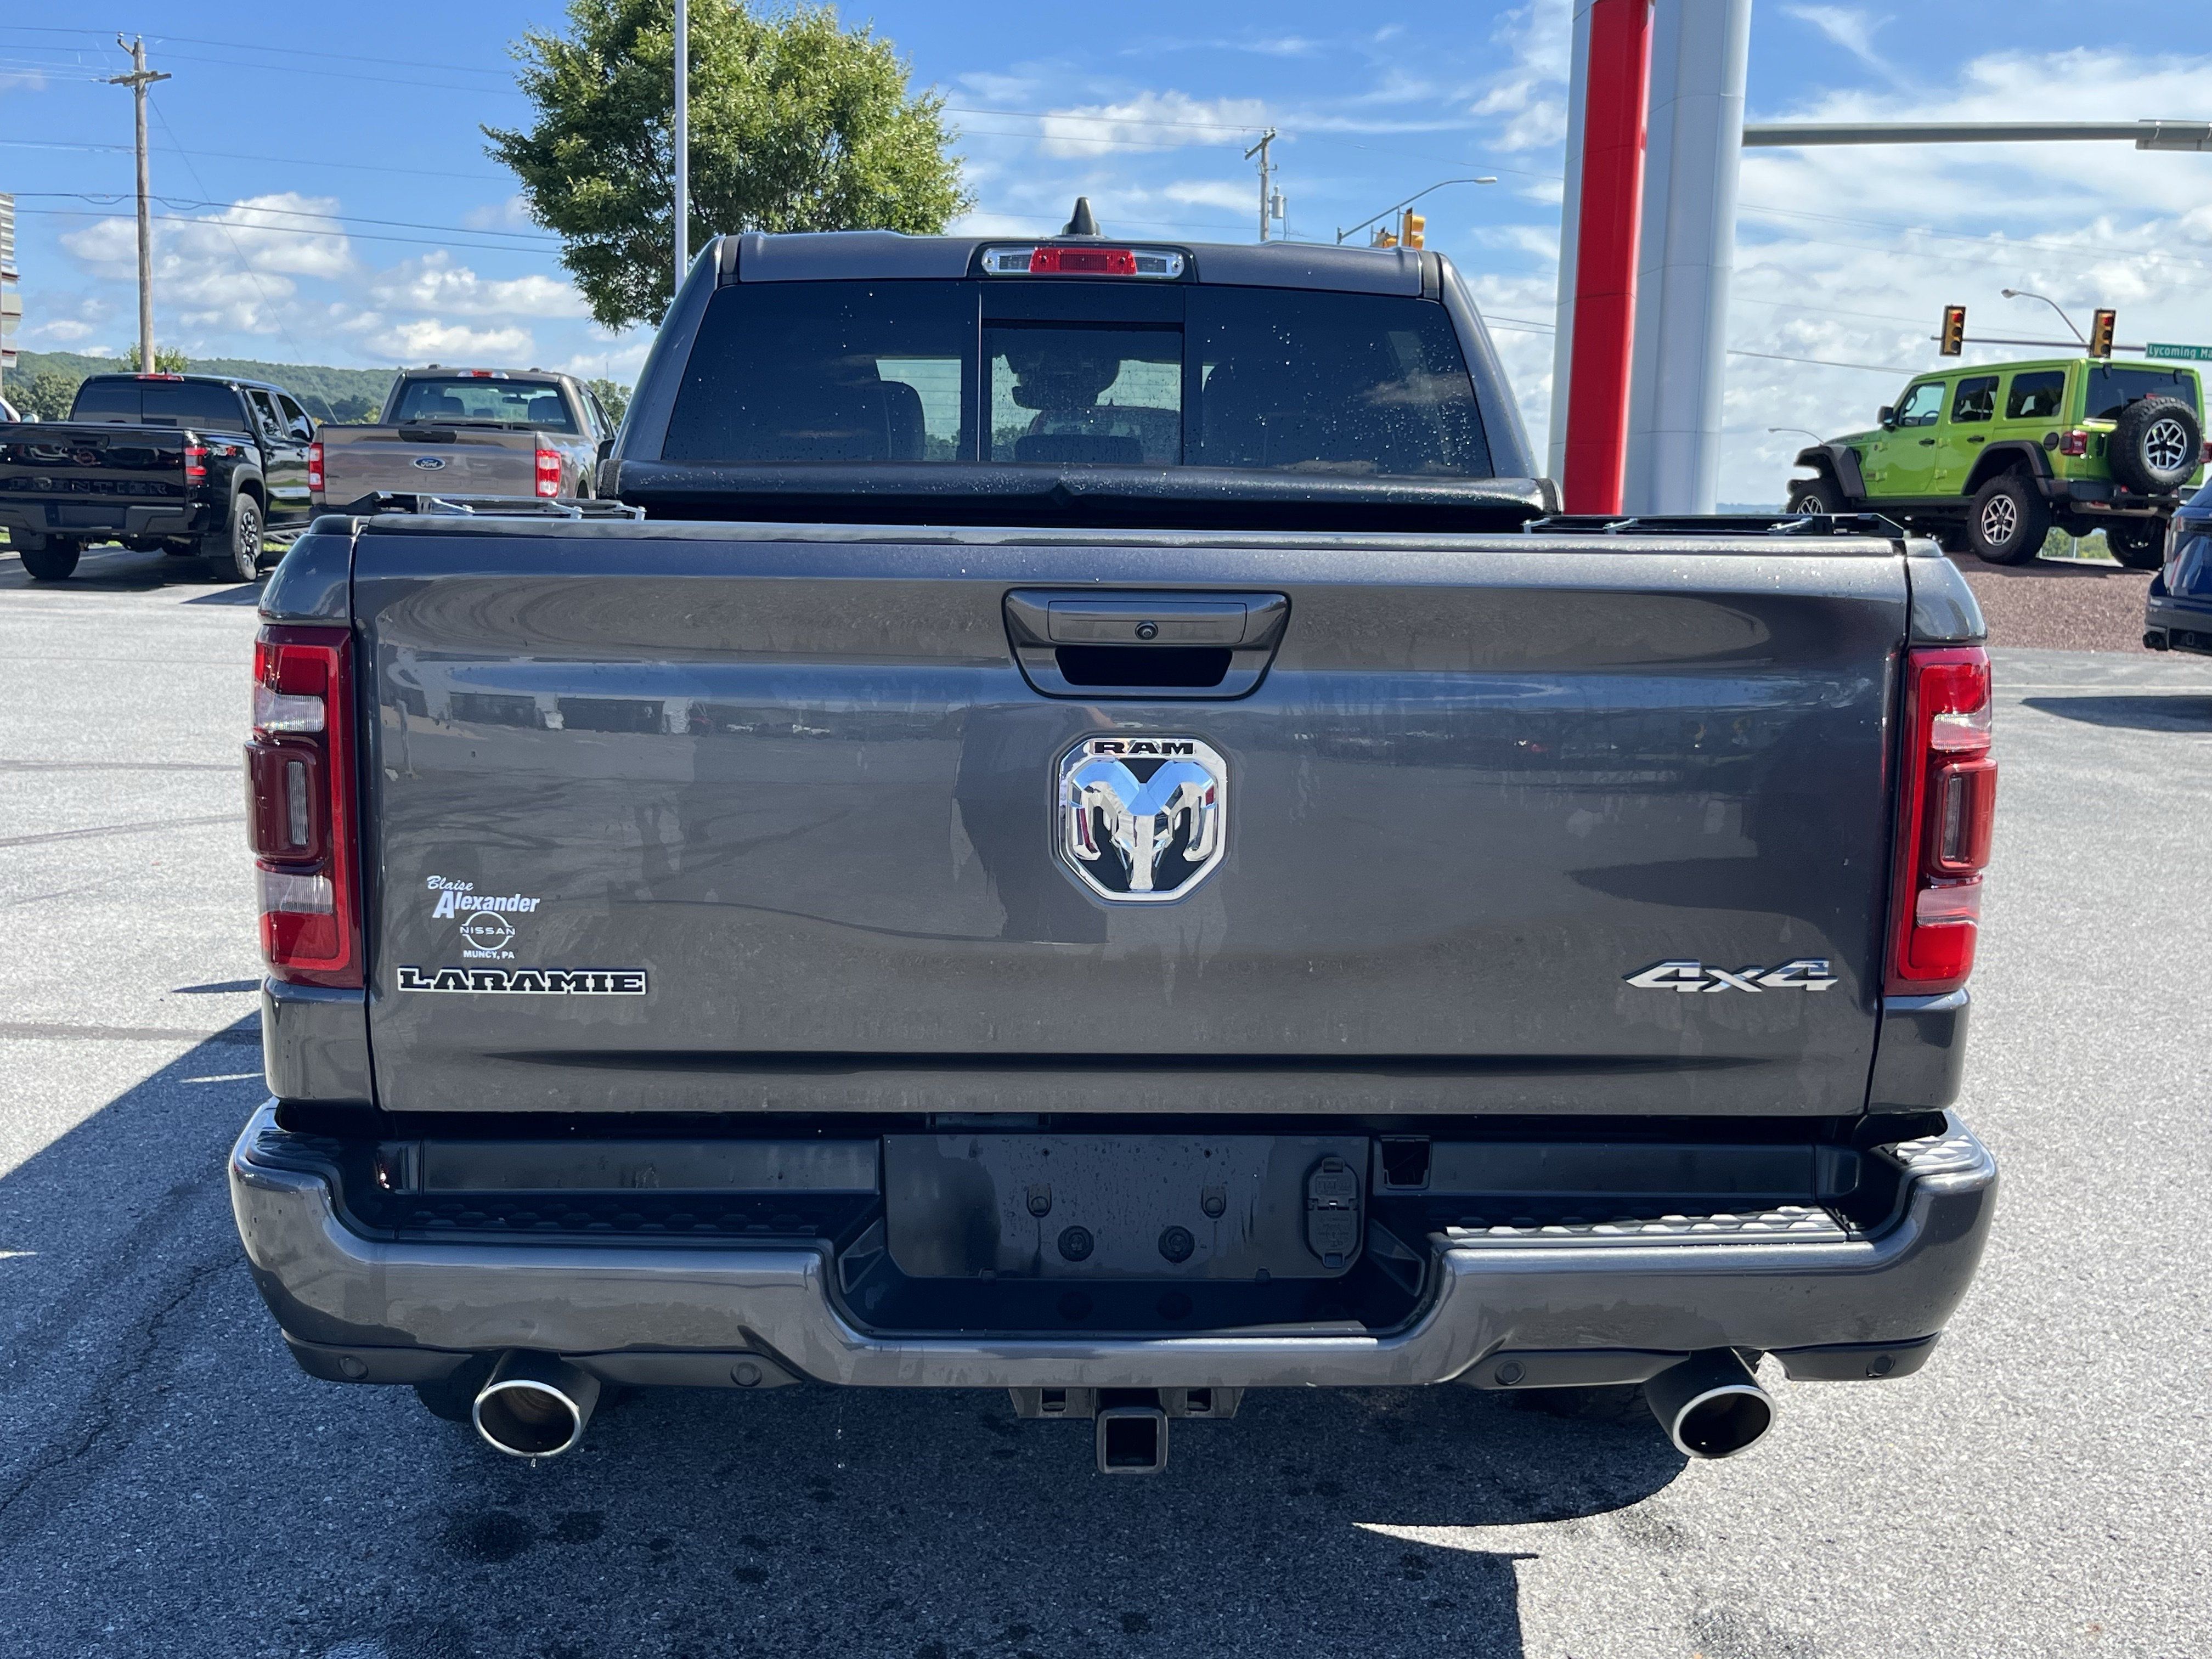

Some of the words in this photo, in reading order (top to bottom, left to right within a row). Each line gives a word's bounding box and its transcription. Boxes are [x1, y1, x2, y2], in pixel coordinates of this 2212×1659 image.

[2149, 345, 2197, 359] Lycoming
[1094, 741, 1194, 754] RAM
[427, 875, 474, 891] Blaise
[432, 890, 541, 919] Alexander
[460, 927, 516, 935] NISSAN
[464, 950, 500, 960] MUNCY,
[502, 951, 515, 959] PA
[397, 968, 646, 995] LARAMIE
